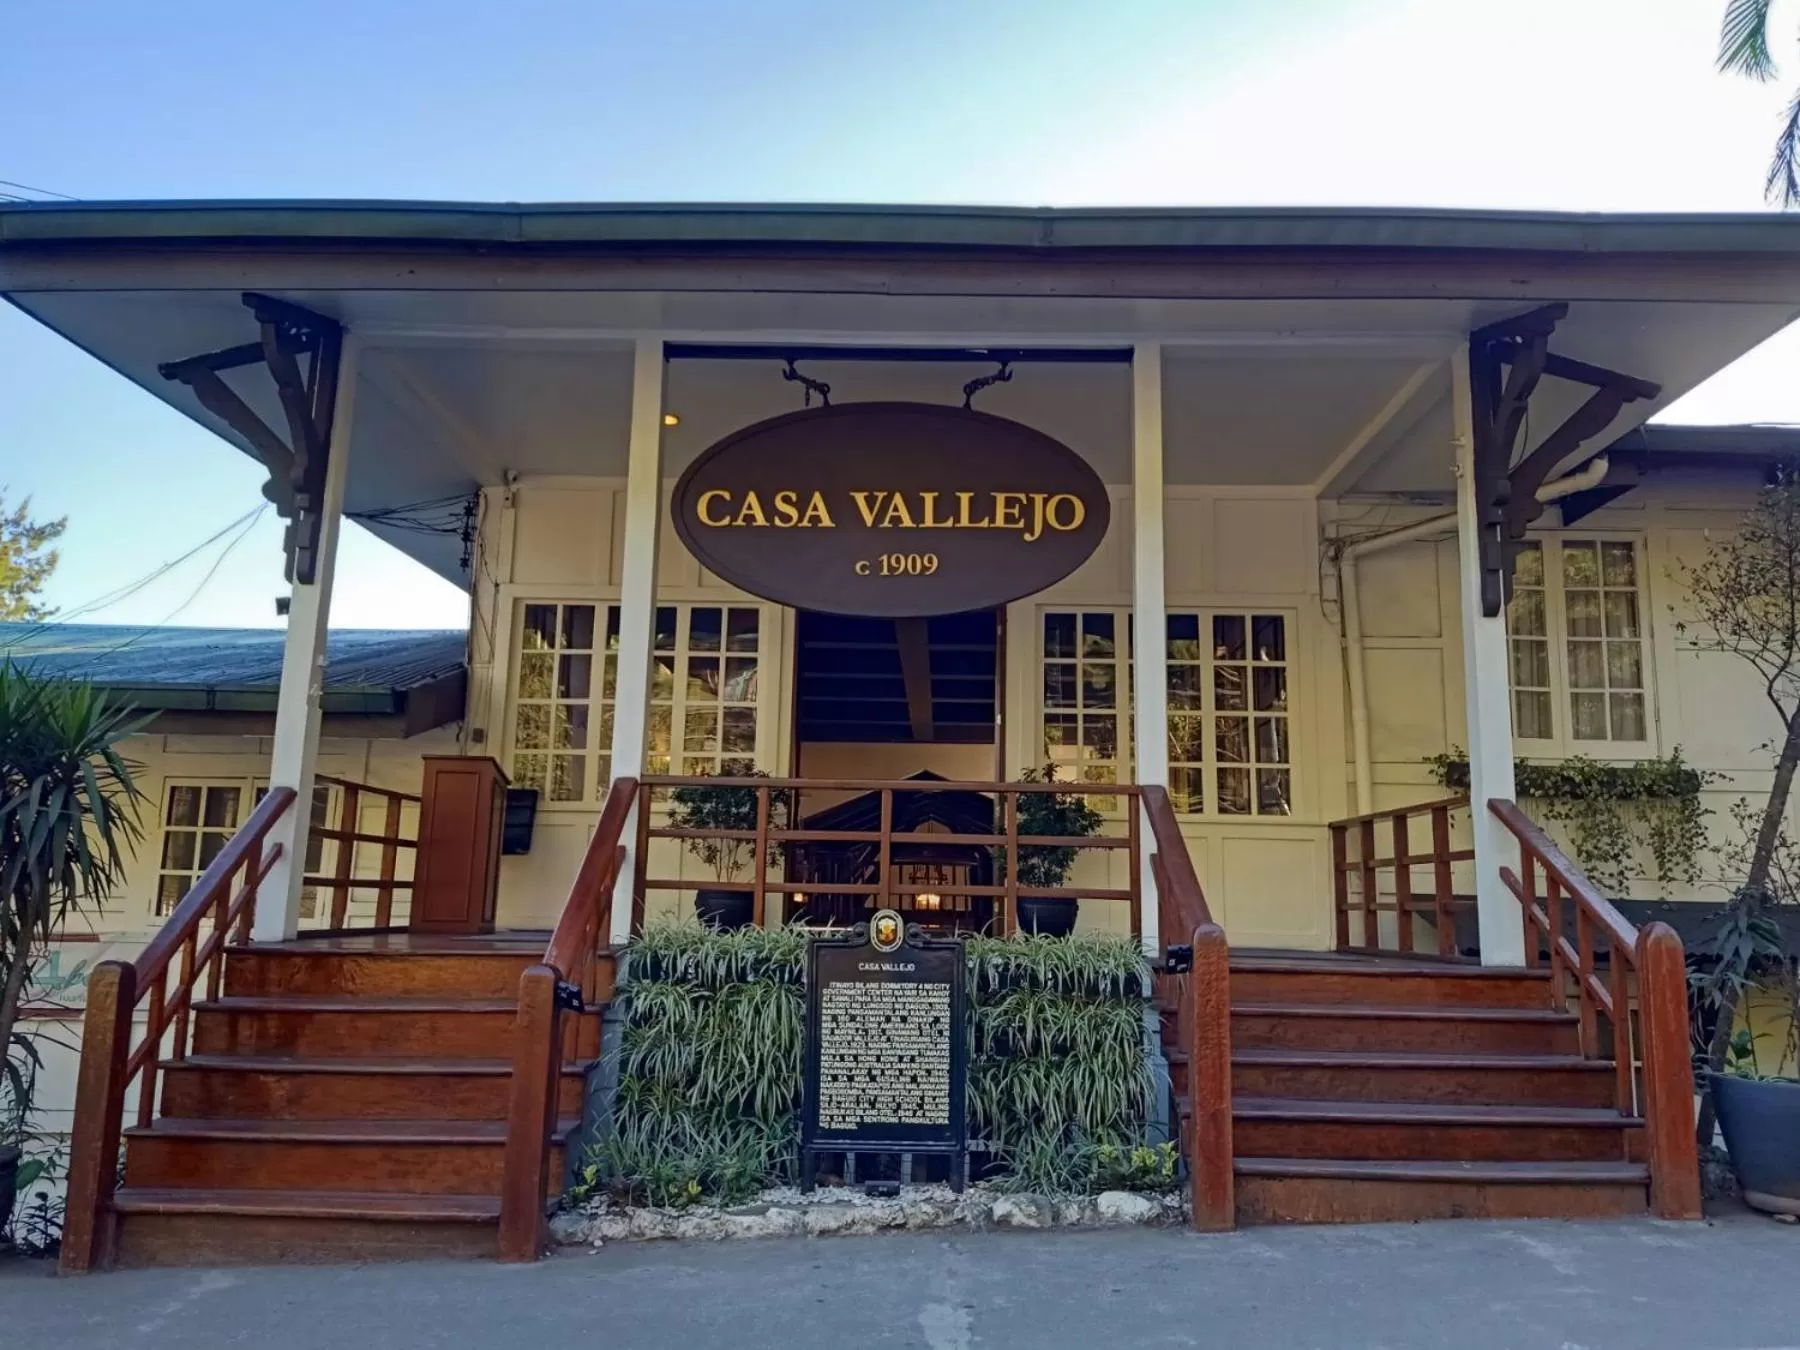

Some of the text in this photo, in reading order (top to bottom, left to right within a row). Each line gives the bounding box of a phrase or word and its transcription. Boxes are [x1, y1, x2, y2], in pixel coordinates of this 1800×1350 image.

[696, 490, 1086, 542] CASA VALLEJO
[878, 553, 938, 576] 1909
[858, 963, 915, 972] CASA VALLEJO
